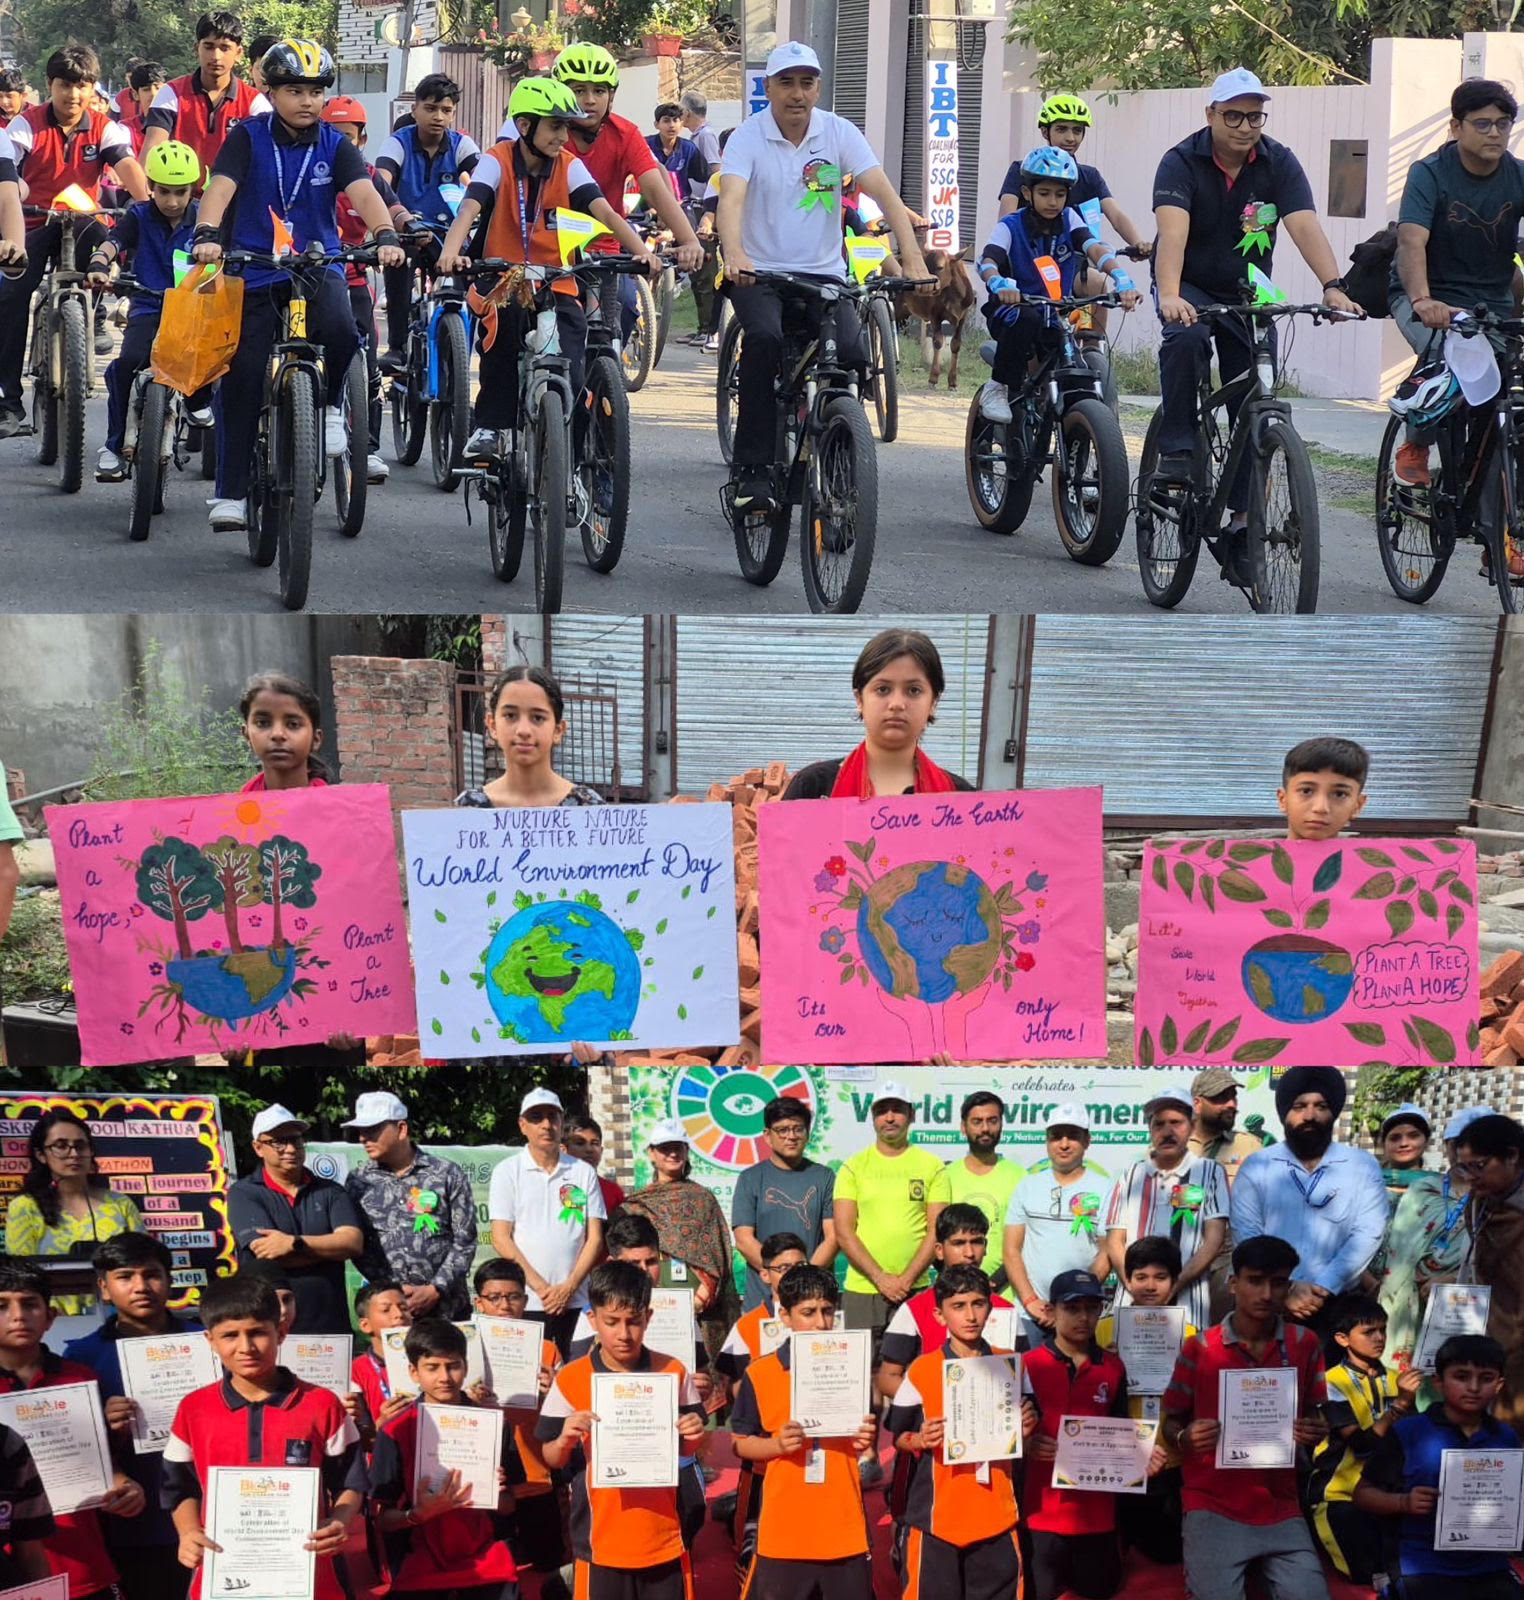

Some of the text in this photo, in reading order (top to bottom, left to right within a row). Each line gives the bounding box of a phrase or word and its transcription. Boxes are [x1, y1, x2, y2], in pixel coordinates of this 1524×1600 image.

[929, 63, 957, 137] IBT
[932, 153, 954, 164] FOR
[930, 168, 955, 185] SSC
[933, 186, 958, 206] JK
[930, 209, 955, 228] SSB
[494, 808, 648, 830] NURTURE NATURE
[870, 801, 1024, 830] Save The Earth
[69, 819, 123, 848] Plant
[457, 827, 645, 849] FOR A BETTER FUTURE
[413, 842, 723, 893] World Environment Day
[86, 870, 102, 887] a
[73, 903, 131, 943] hope,
[343, 922, 395, 951] Plant
[367, 956, 380, 970] a
[1363, 950, 1462, 973] PLANT A TREE
[350, 977, 391, 1003] Tree
[1403, 976, 1415, 996] A
[1420, 976, 1461, 995] HOPE
[1016, 997, 1060, 1026] only
[815, 1023, 846, 1036] our
[1011, 1076, 1075, 1092] celebrates
[851, 1092, 952, 1124] Wrld
[90, 1123, 124, 1136] OOL
[127, 1122, 196, 1136] KATHUA
[916, 1132, 957, 1143] Theme:
[112, 1177, 210, 1191] The journey
[147, 1198, 178, 1209] of a
[143, 1214, 199, 1228] ousand
[160, 1232, 211, 1247] begins
[177, 1254, 188, 1265] a
[171, 1271, 202, 1285] step
